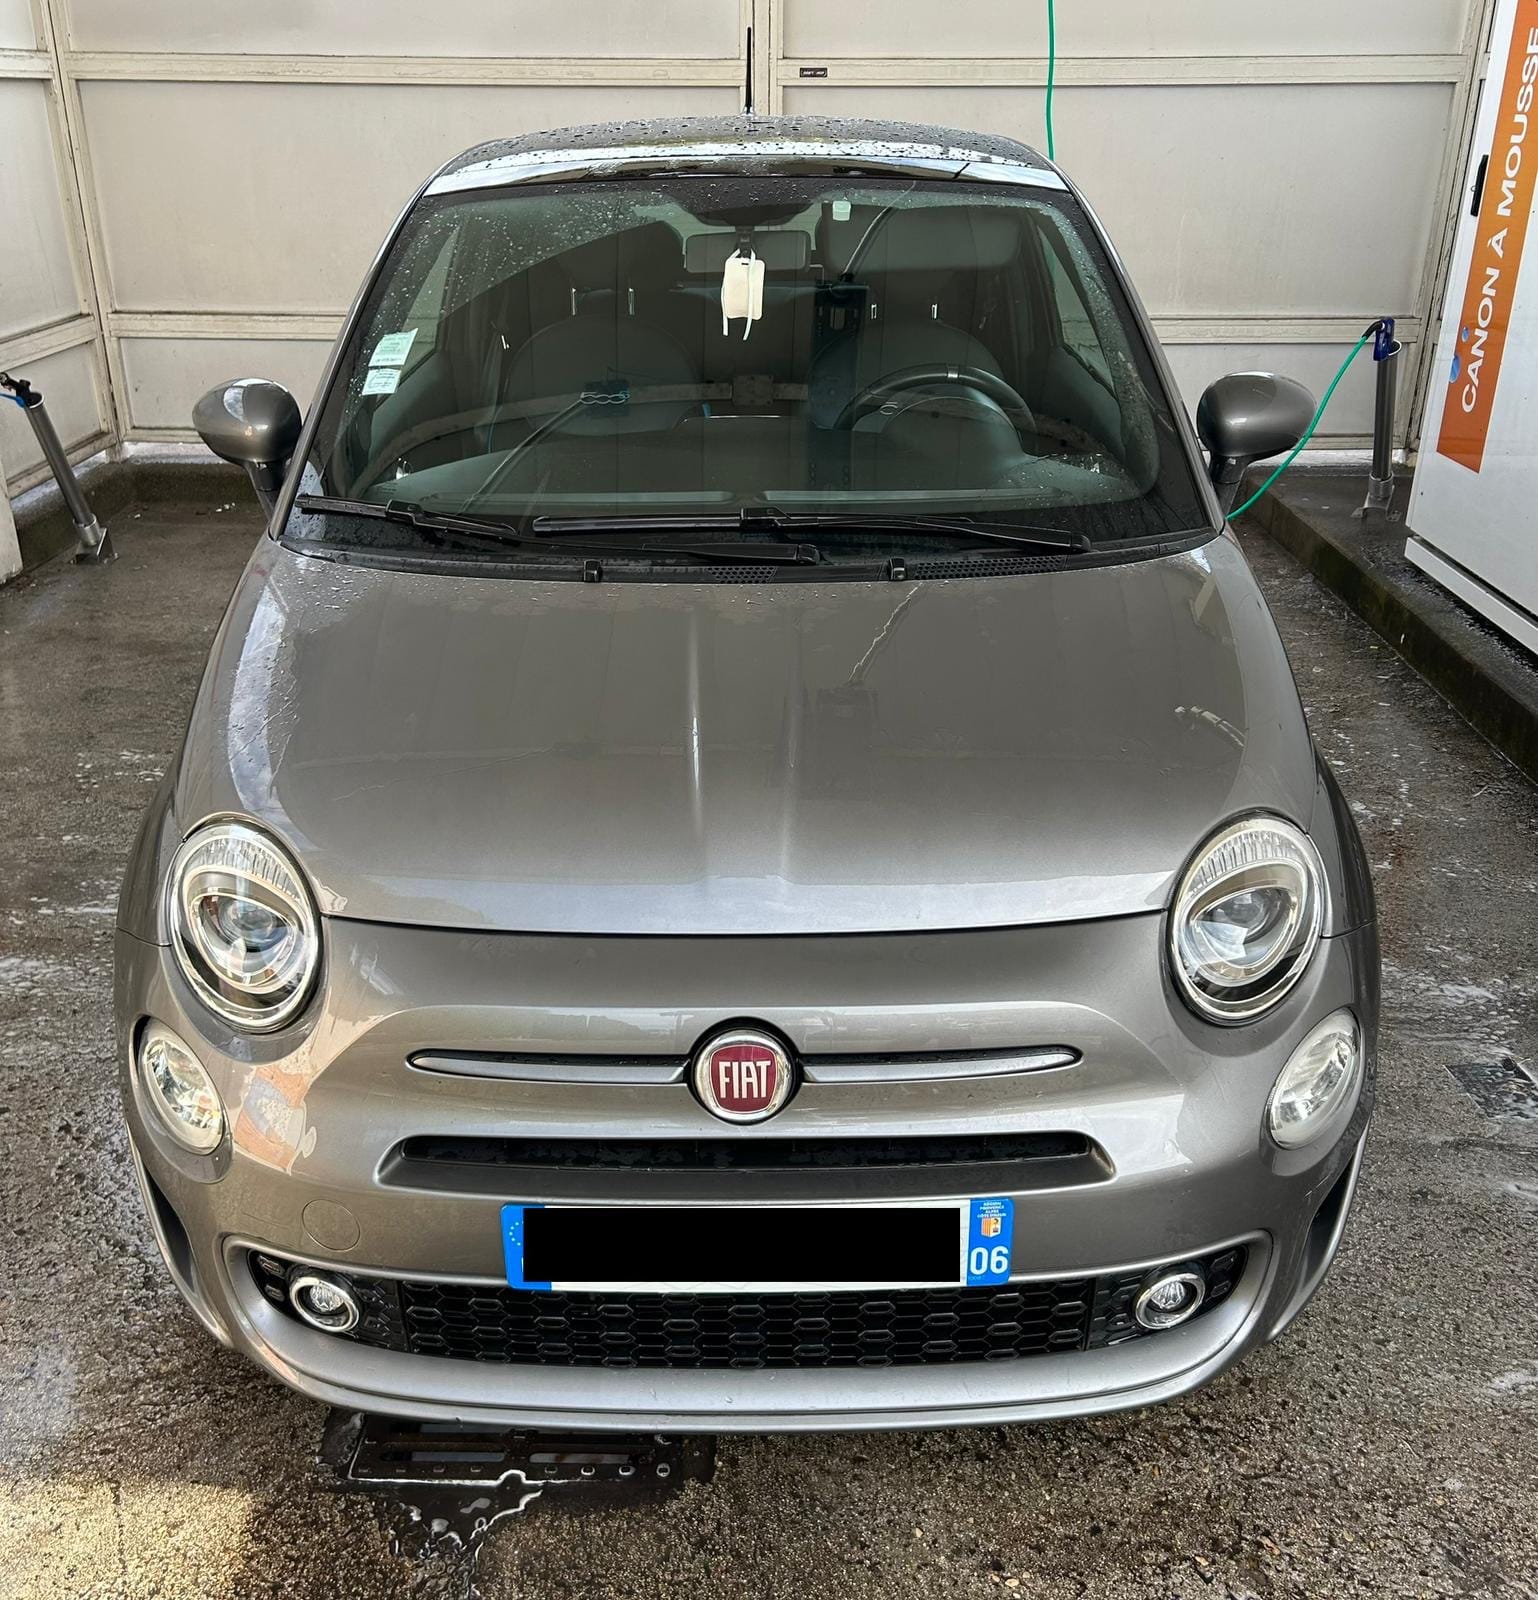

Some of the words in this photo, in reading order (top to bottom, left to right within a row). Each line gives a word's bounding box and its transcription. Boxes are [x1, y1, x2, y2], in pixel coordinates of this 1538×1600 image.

[1496, 26, 1538, 217] MOUSSE
[1487, 227, 1508, 259] À
[1462, 266, 1500, 413] CANON
[718, 1060, 771, 1099] FIAT
[970, 1245, 1009, 1275] 06
